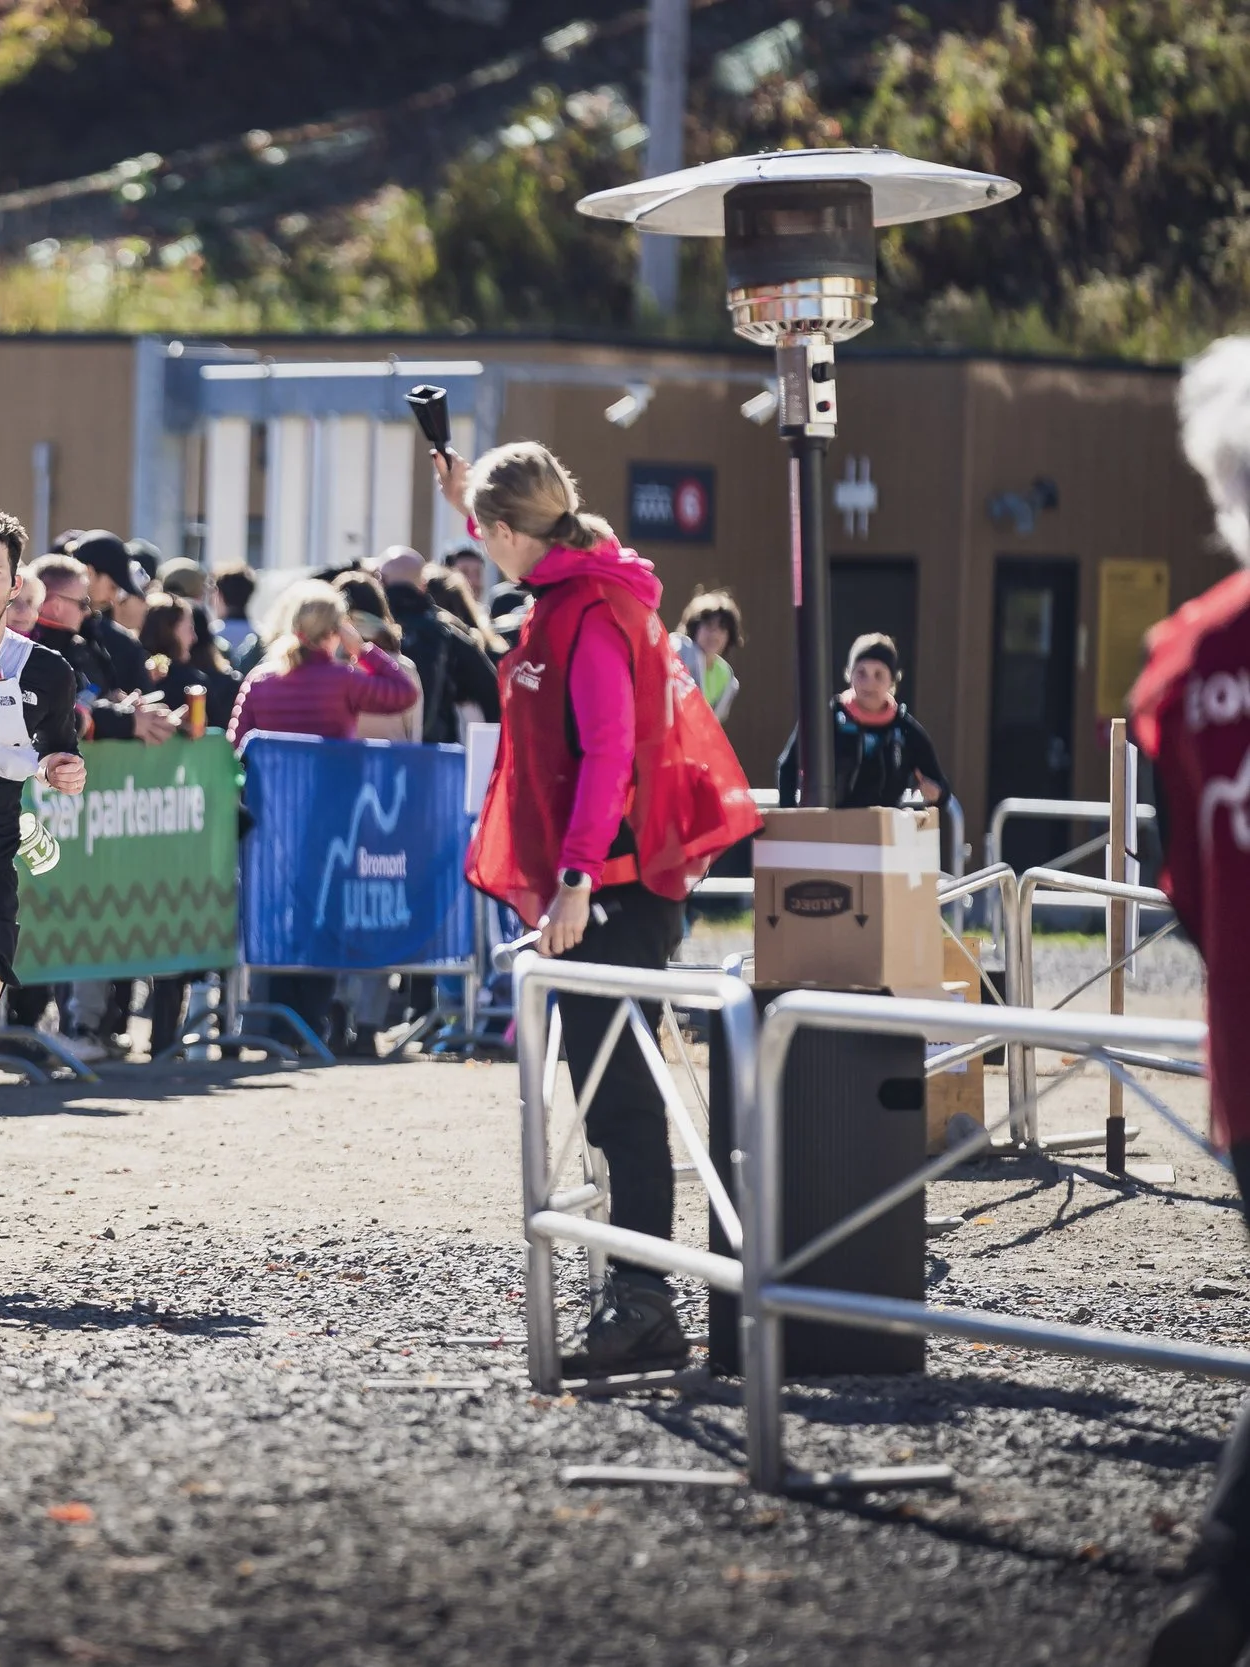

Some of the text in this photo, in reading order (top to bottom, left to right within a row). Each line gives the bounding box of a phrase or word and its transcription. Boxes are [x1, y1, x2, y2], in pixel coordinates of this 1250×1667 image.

[85, 764, 206, 857] partenaire
[357, 846, 407, 880] Bromont
[343, 879, 412, 931] ULTRA
